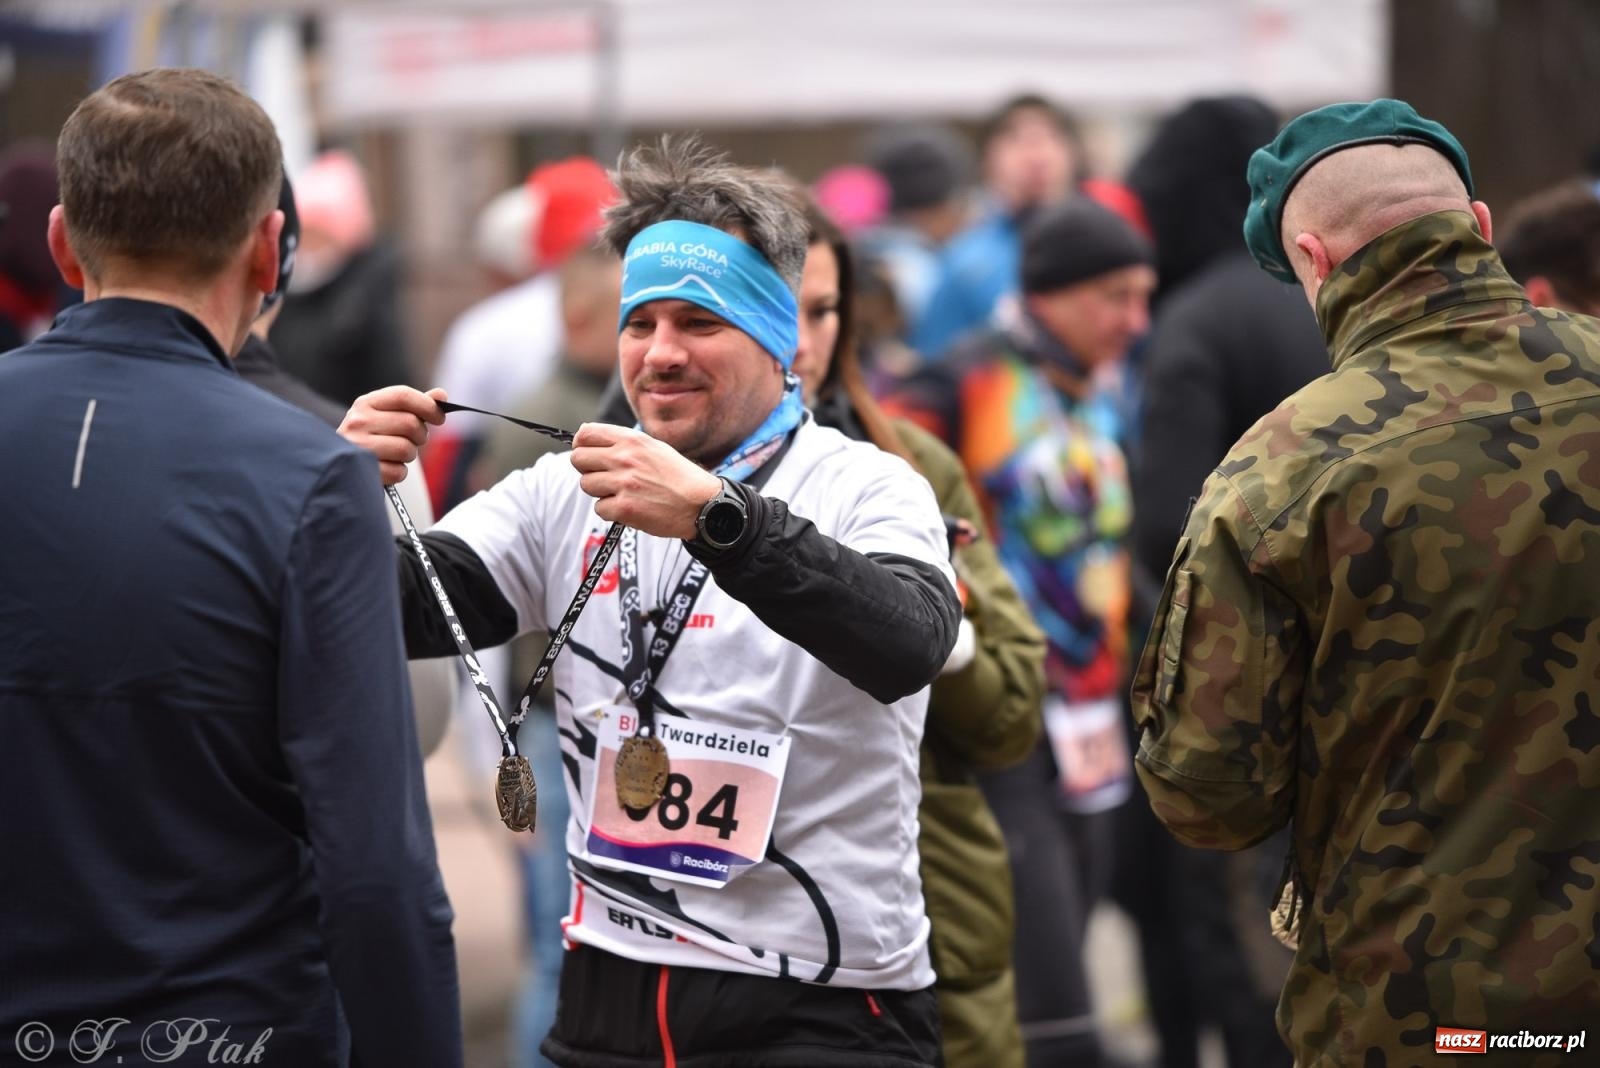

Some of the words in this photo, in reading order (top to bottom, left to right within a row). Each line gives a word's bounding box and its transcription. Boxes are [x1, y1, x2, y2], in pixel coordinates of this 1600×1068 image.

[660, 254, 722, 279] SkyRace
[680, 242, 729, 267] GÓRA
[650, 637, 670, 658] 13
[532, 665, 549, 686] 13
[660, 723, 771, 758] Twardziela
[625, 772, 739, 840] 84
[683, 855, 729, 874] Racibórz
